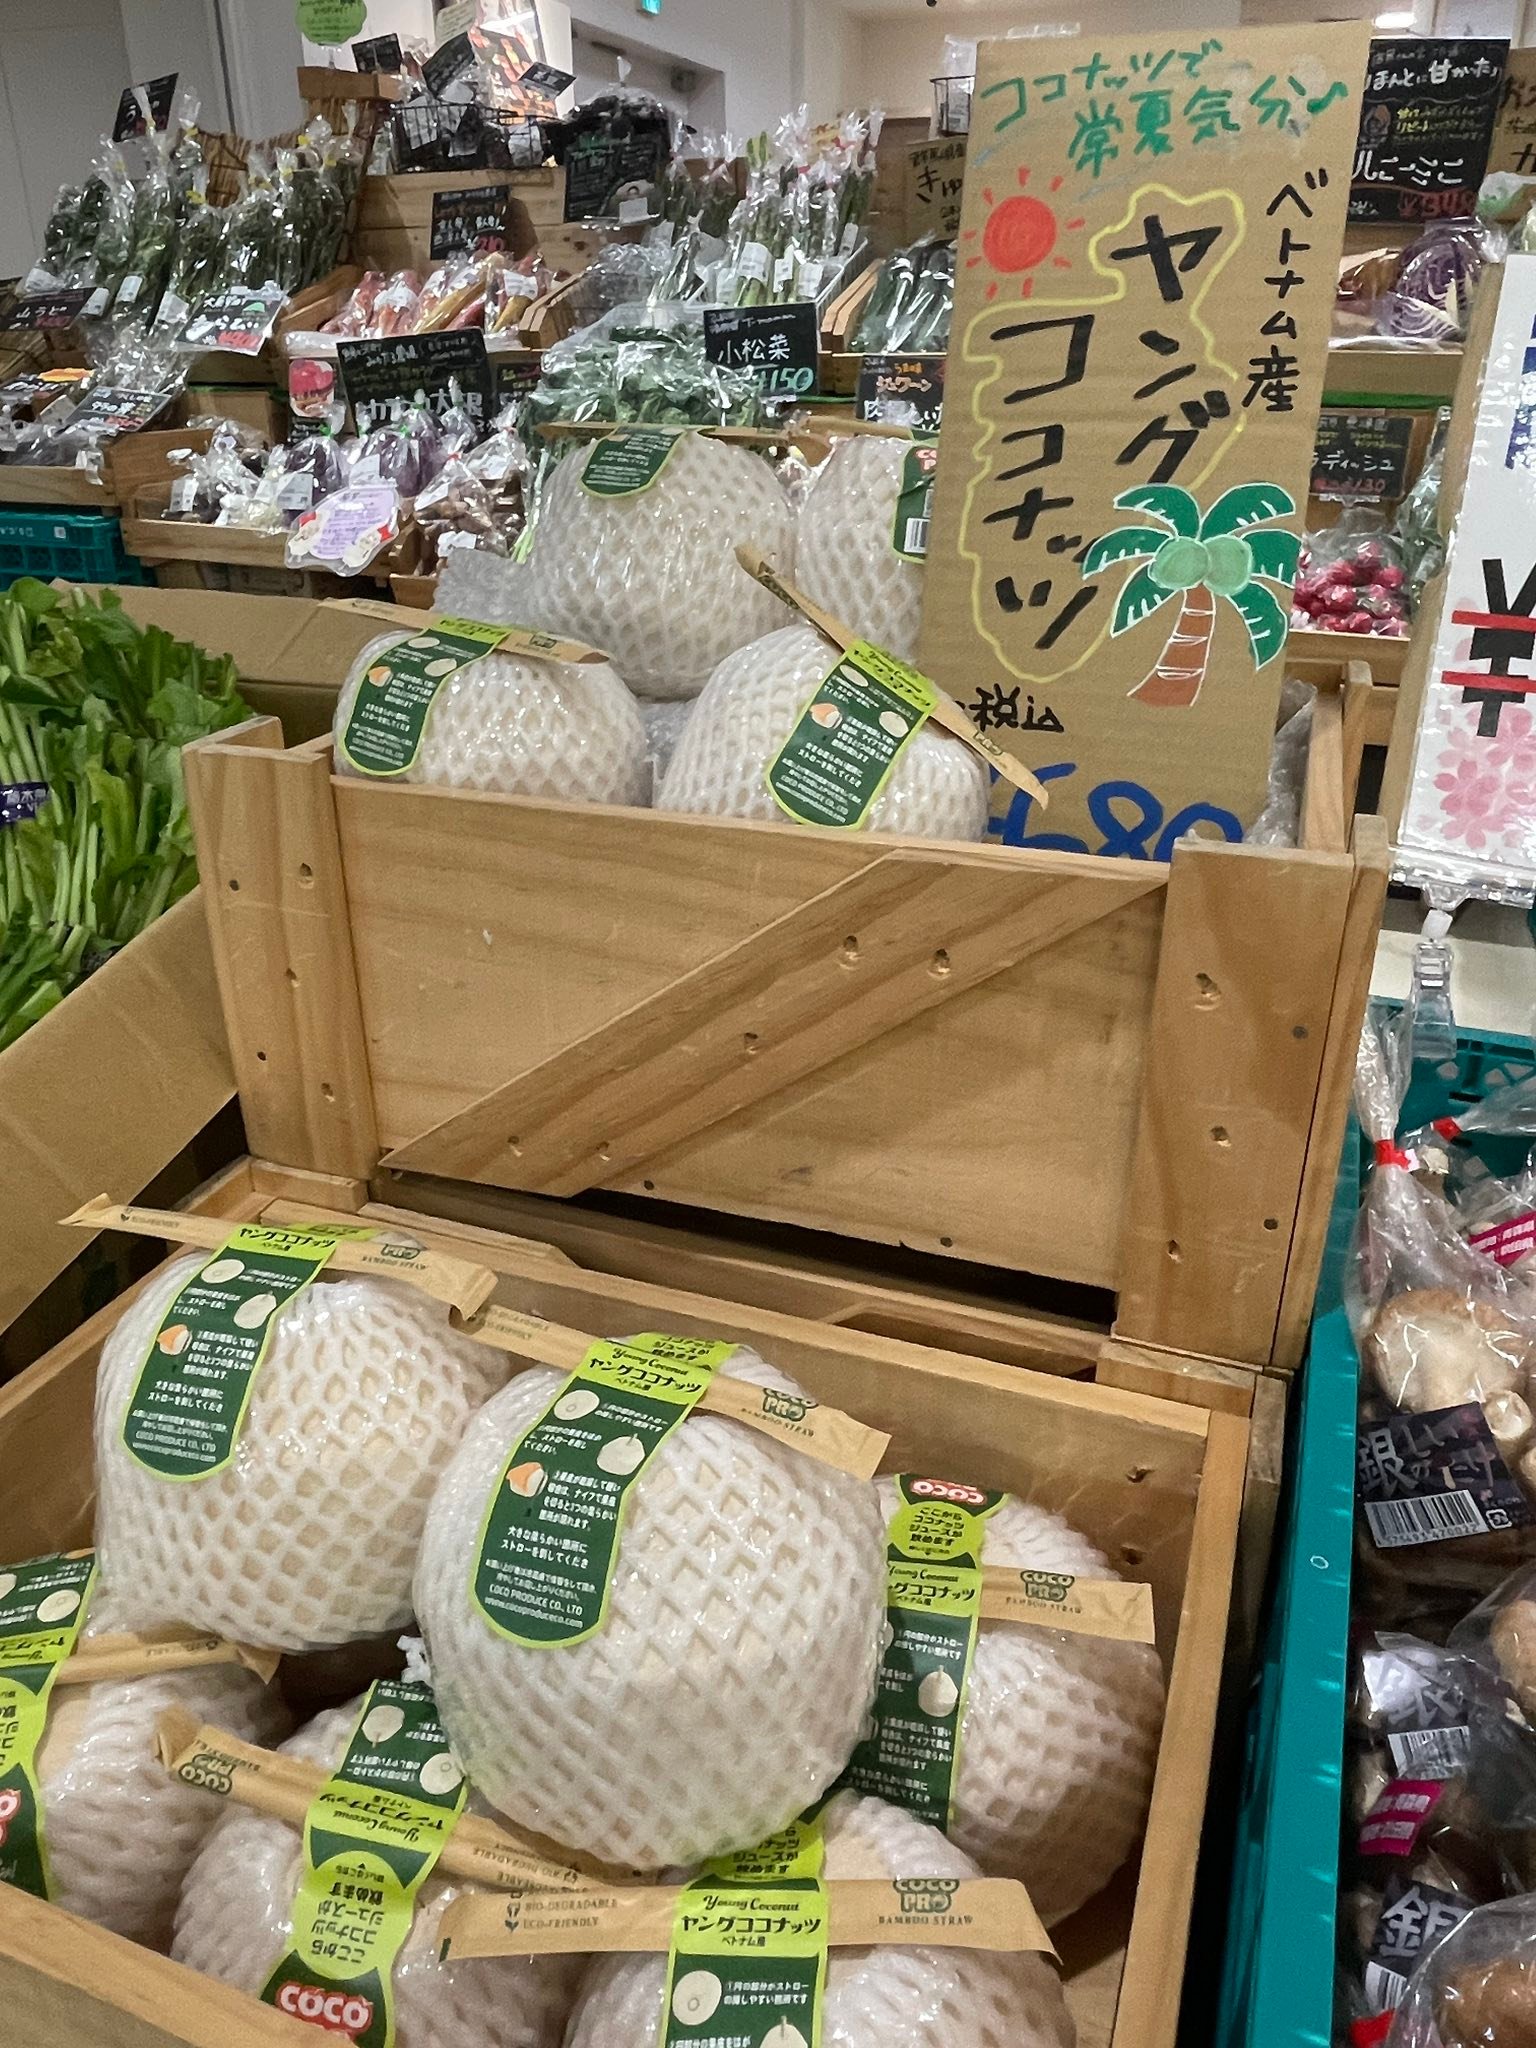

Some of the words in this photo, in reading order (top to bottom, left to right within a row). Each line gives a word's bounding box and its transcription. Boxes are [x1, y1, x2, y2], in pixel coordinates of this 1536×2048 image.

[980, 39, 1223, 132] ココナッツで
[1242, 167, 1330, 412] ベトナム産
[717, 333, 791, 364] 小松菜
[1110, 214, 1231, 485] ヤング
[982, 314, 1101, 650] ココナッツ
[239, 1226, 337, 1248] ヤングココナッツ
[611, 1346, 648, 1367] Young
[588, 1357, 702, 1393] ヤングココナッツ
[763, 1396, 806, 1422] PRO
[783, 1422, 815, 1438] STRAW
[489, 1584, 511, 1598] COCO
[511, 1588, 549, 1608] PRODUCE
[318, 1793, 444, 1832] ヤングココナッツ
[332, 1808, 380, 1831] Coconut
[378, 1819, 420, 1843] Young
[328, 1880, 385, 1907] 飲めます
[703, 1894, 748, 1911] Young
[749, 1897, 800, 1912] Coconut
[901, 1891, 952, 1913] PRO
[317, 1900, 386, 1926] ジュースが
[523, 1916, 600, 1930] ECO-FRIENDLY
[681, 1914, 822, 1935] ヤングココナッツ
[878, 1915, 929, 1926] BAMBOO
[932, 1915, 974, 1927] STRAW
[310, 1918, 378, 1946] ココナッツ
[721, 1935, 767, 1948] ベトナム産
[310, 1938, 367, 1964] ここから
[278, 1983, 372, 2031] COCO
